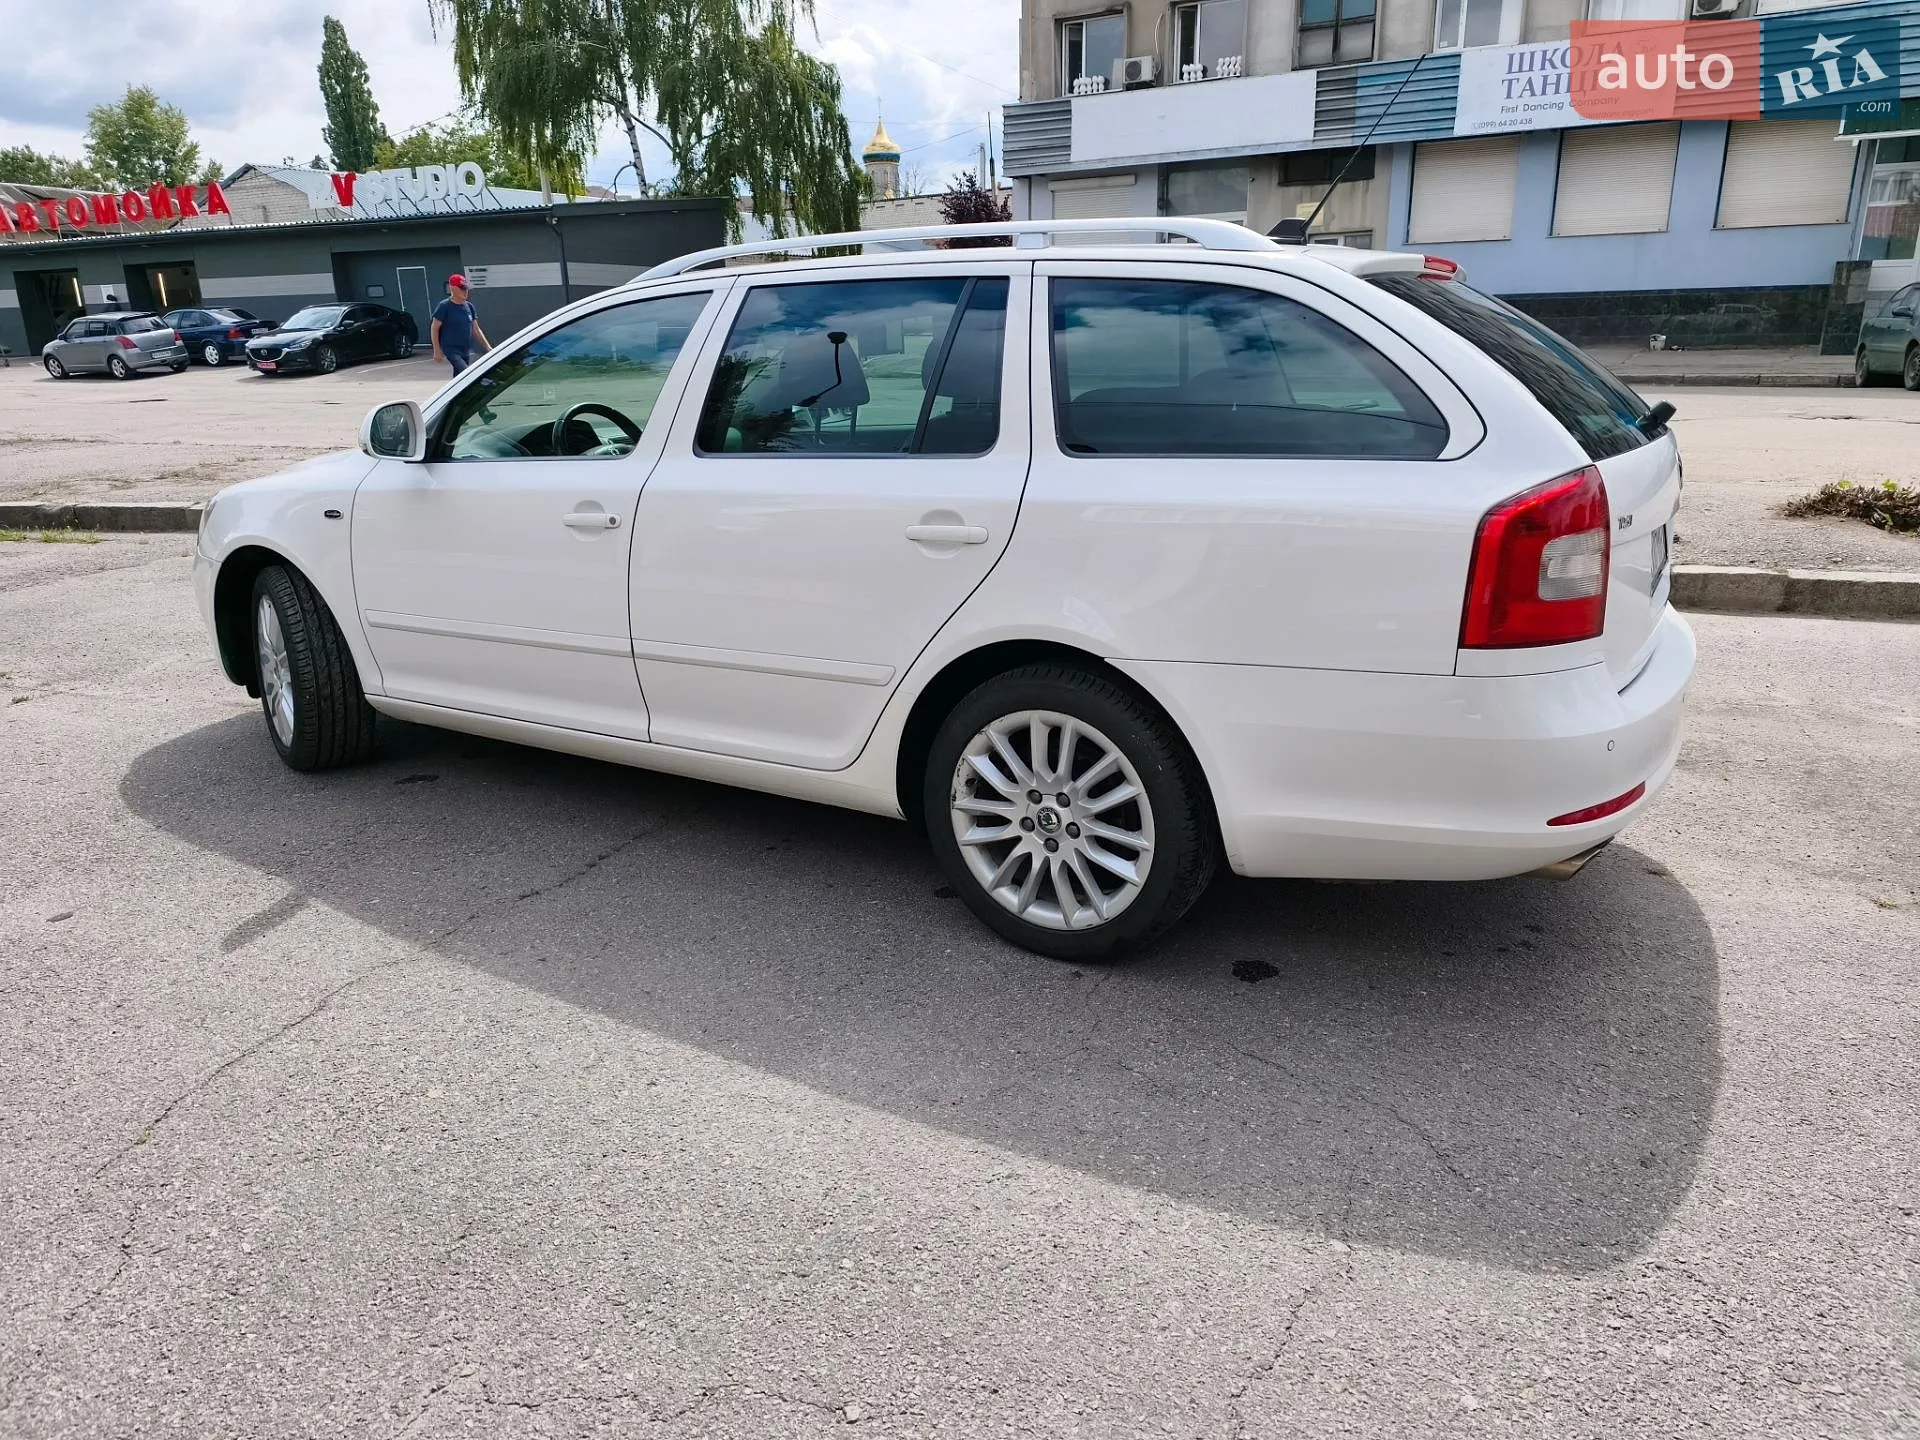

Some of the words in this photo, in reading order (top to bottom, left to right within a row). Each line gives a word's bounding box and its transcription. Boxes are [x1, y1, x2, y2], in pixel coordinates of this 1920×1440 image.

[1500, 104, 1519, 114] First
[1523, 100, 1564, 112] Dancing
[1569, 95, 1620, 109] Company
[366, 161, 486, 205] STUDIO
[0, 180, 232, 232] АВТОМОЙКА
